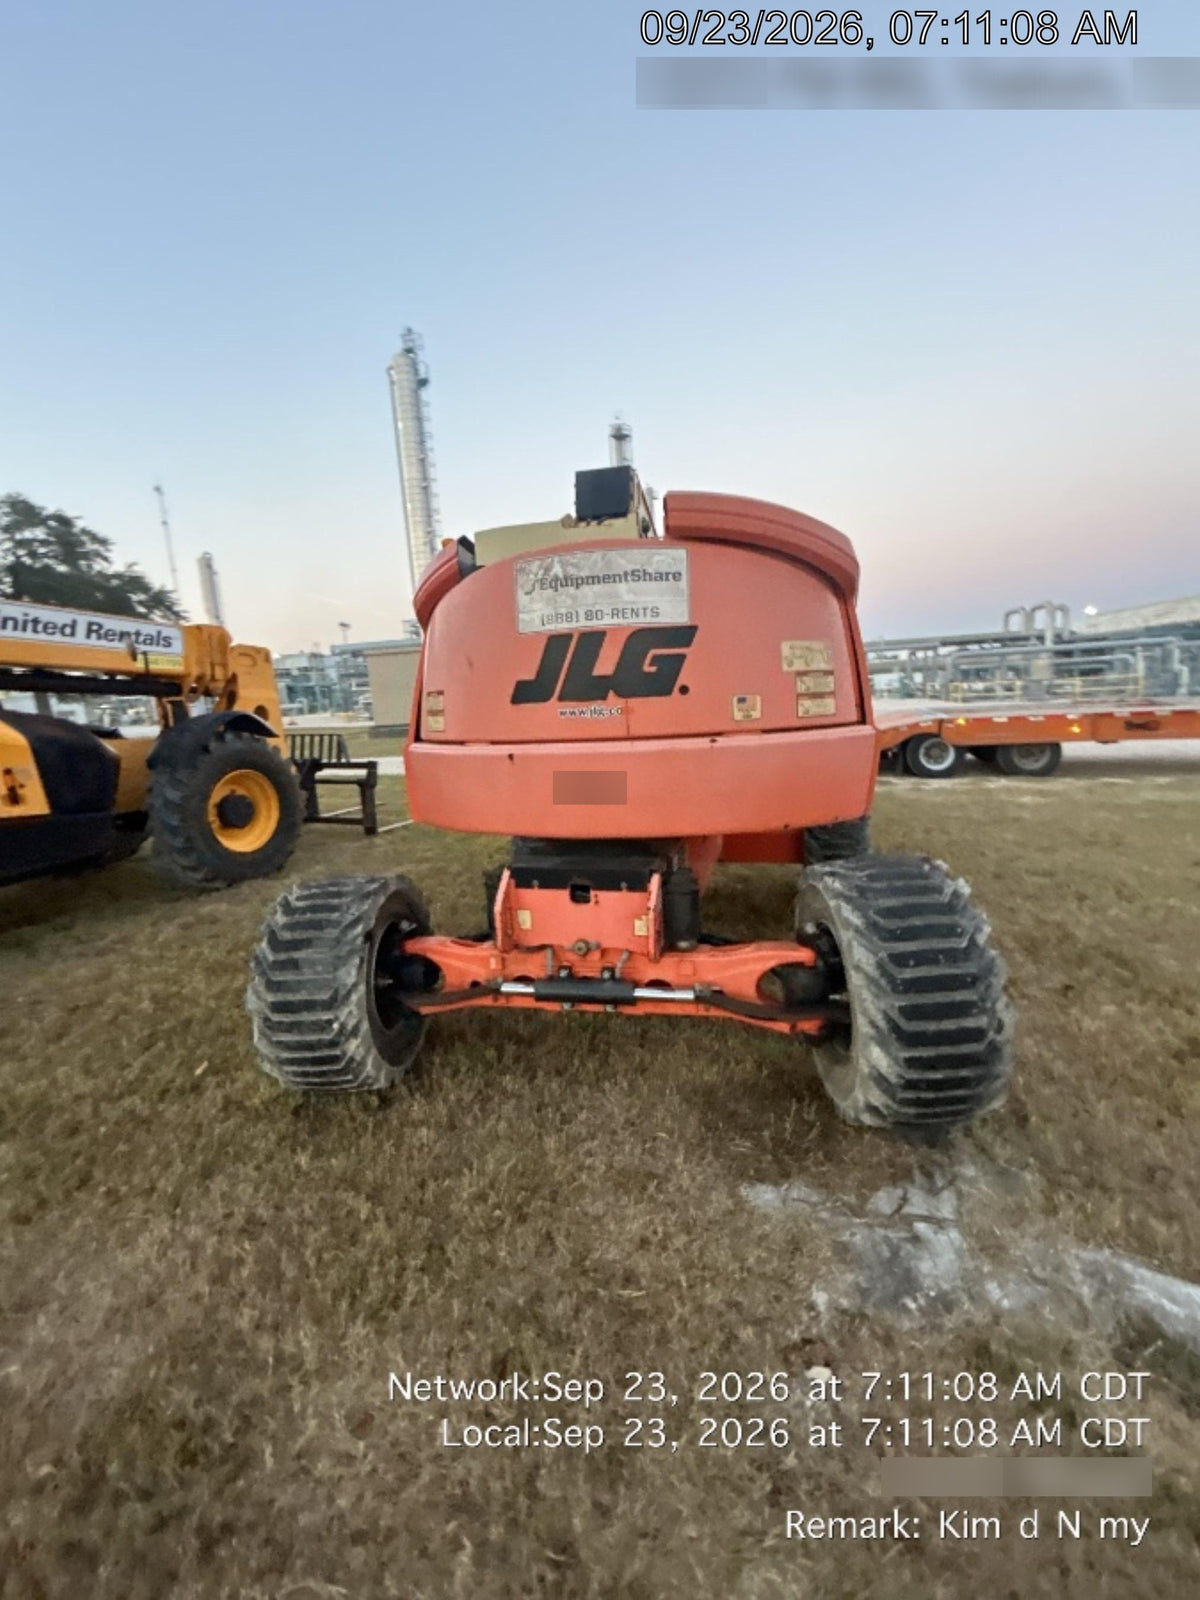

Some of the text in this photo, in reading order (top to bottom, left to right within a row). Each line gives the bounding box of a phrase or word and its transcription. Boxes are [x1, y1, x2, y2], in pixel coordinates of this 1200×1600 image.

[539, 569, 683, 592] EquipmentShare
[584, 606, 660, 621] 80-RENTS
[0, 612, 173, 648] nited Rentals
